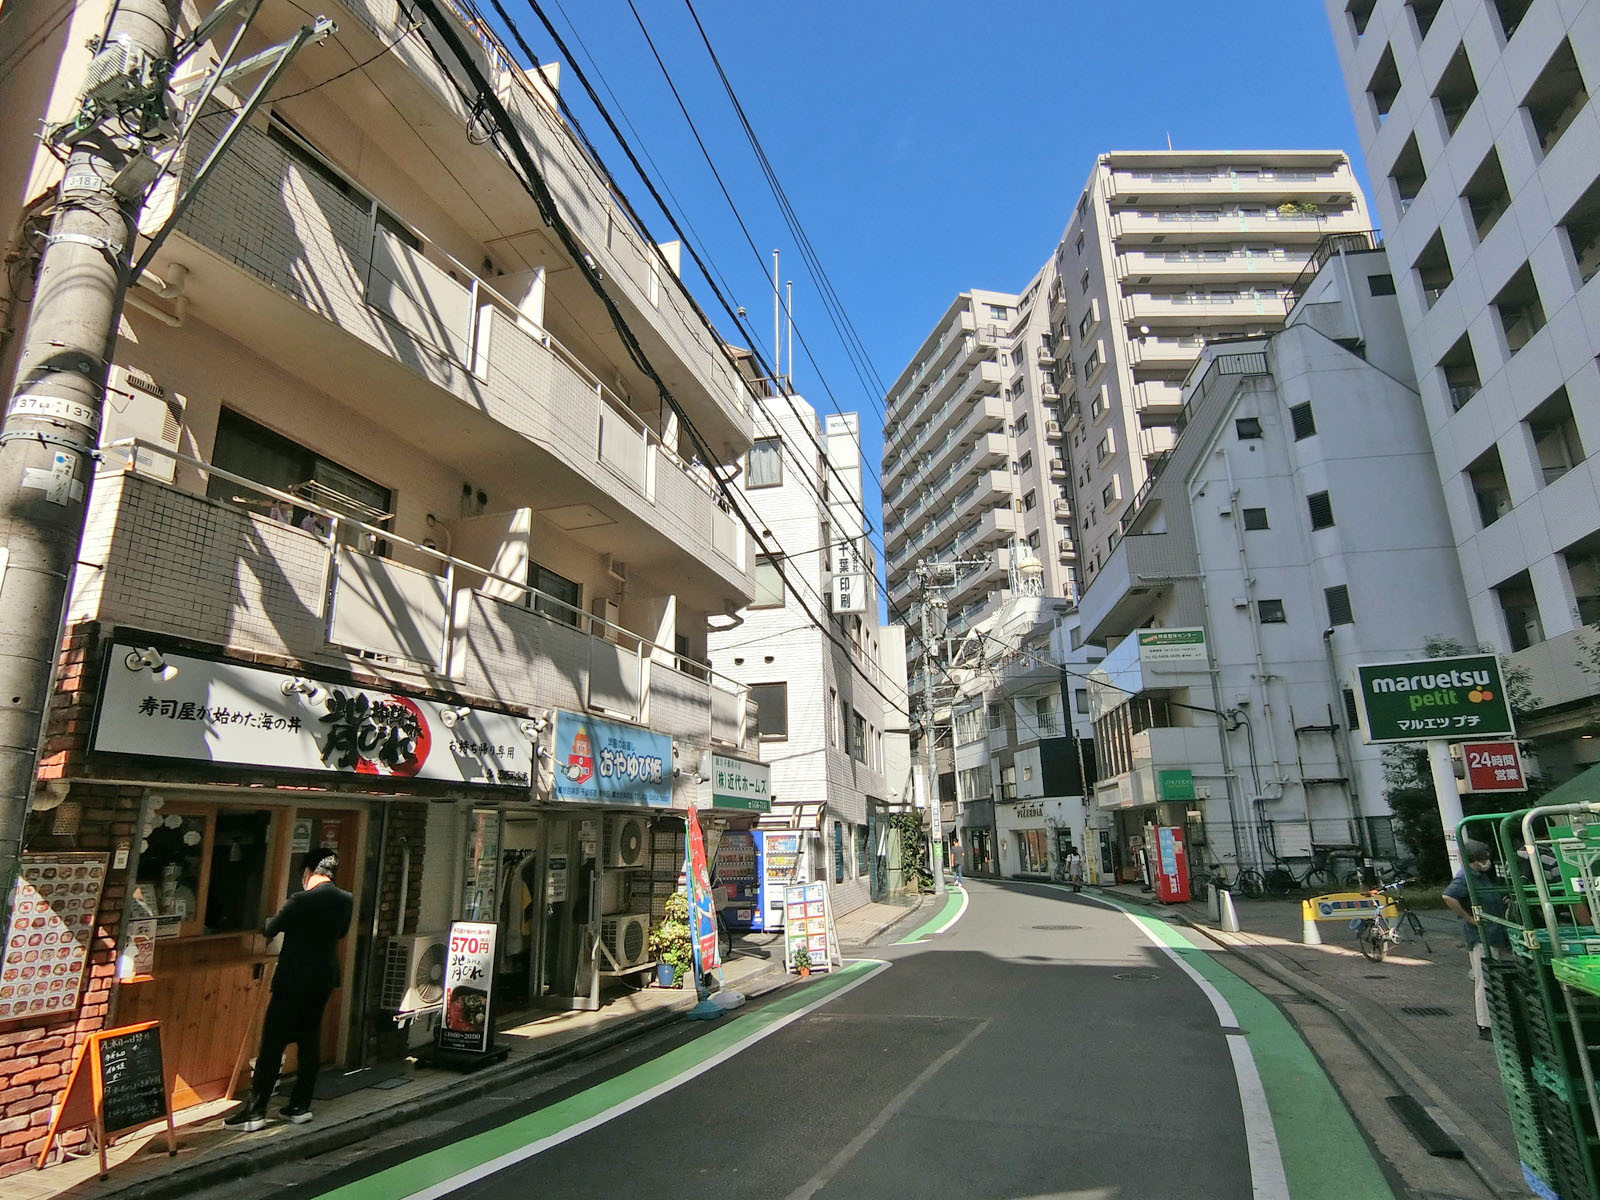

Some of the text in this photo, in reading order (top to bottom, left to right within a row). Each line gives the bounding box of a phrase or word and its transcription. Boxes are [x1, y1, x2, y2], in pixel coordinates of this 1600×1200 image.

[838, 542, 851, 609] 千葉印刷
[1371, 669, 1490, 693] maruetsu
[1408, 689, 1459, 711] petit
[138, 696, 302, 734] 寿司屋が始めた海の丼
[1397, 715, 1481, 731] マルエツ プチ
[449, 740, 515, 760] お持ち帰り専用
[1469, 752, 1515, 768] 24時間
[1494, 769, 1519, 781] 営業
[451, 937, 489, 953] 570円
